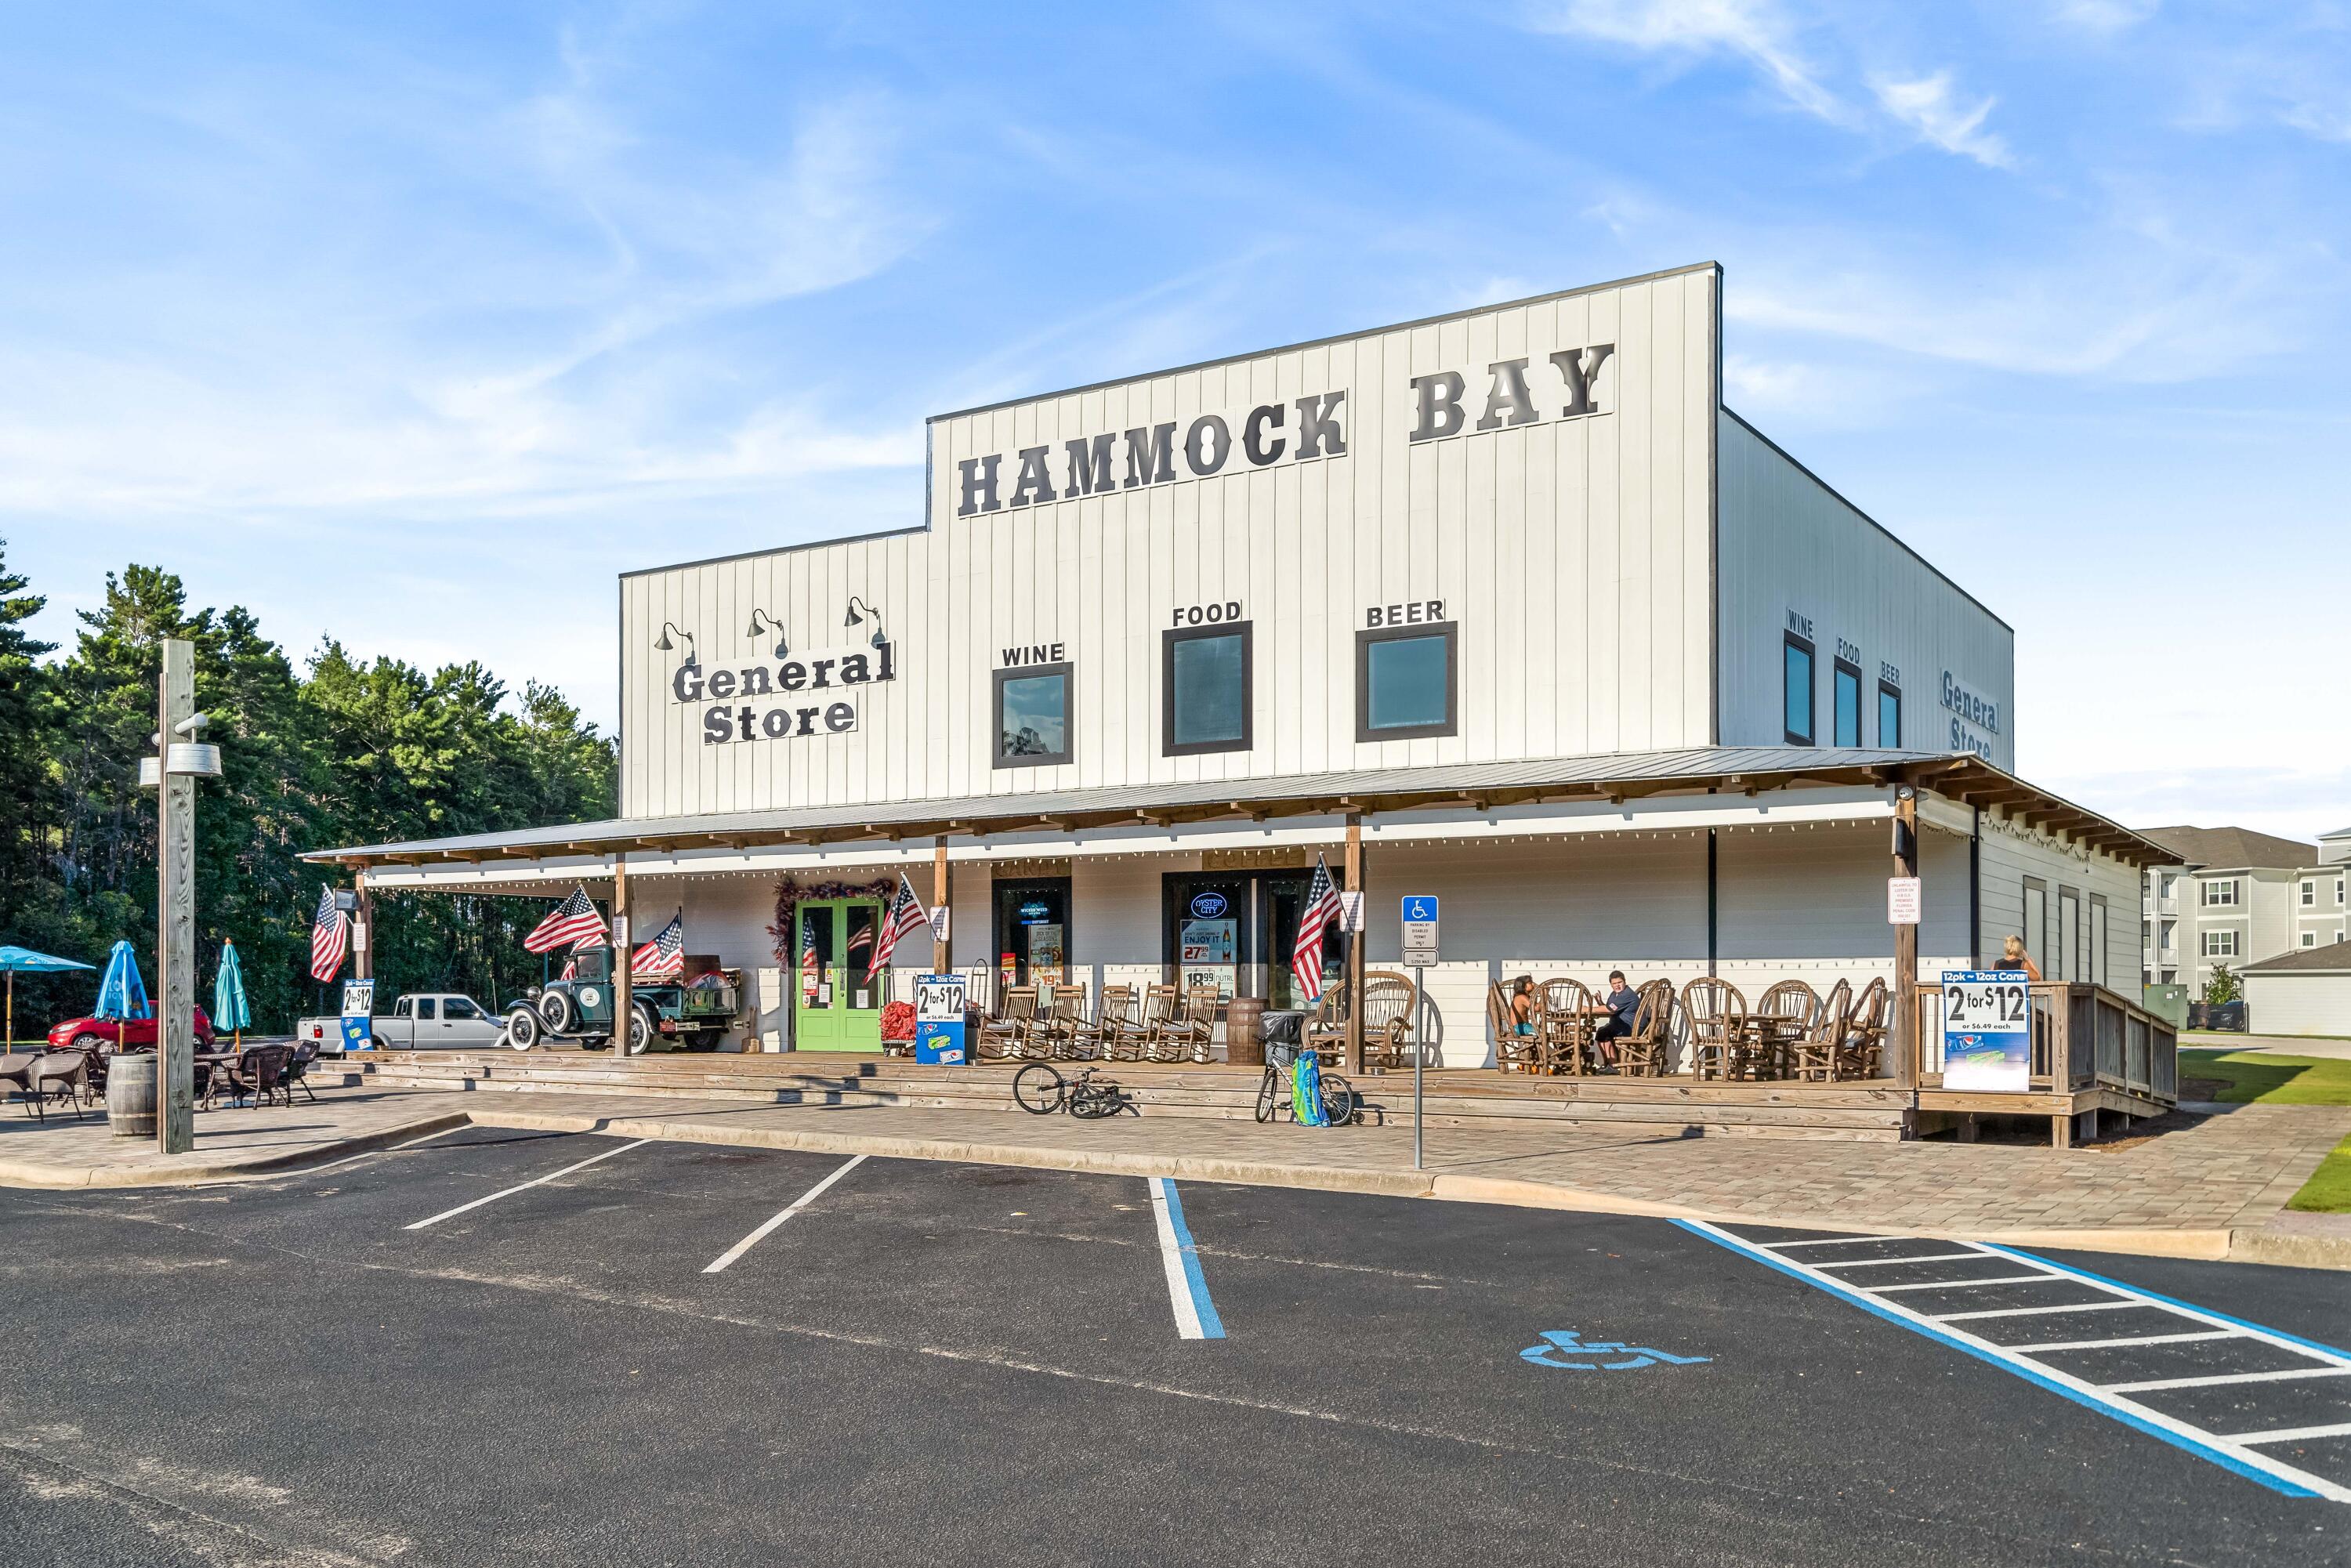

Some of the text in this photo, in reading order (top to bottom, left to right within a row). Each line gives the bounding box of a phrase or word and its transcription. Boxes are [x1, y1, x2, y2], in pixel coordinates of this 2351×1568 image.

[958, 343, 1614, 516] HAMMOCK BAY
[1172, 602, 1241, 626] FOOD
[1367, 600, 1444, 627] BEER
[1788, 610, 1813, 640] WINE
[1002, 643, 1063, 666] WINE
[1838, 637, 1860, 664] FOOD
[672, 643, 893, 701] General
[1882, 661, 1900, 686] BEER
[1943, 671, 1999, 733] General
[704, 702, 854, 744] Store
[1951, 717, 1991, 760] Store
[1943, 972, 1965, 982] 12pk
[1976, 972, 1997, 981] 12oz
[1999, 972, 2025, 981] Cans
[344, 988, 351, 1010] 2
[919, 986, 962, 1013] 2 for $12
[1948, 985, 2024, 1021] 2 for $12
